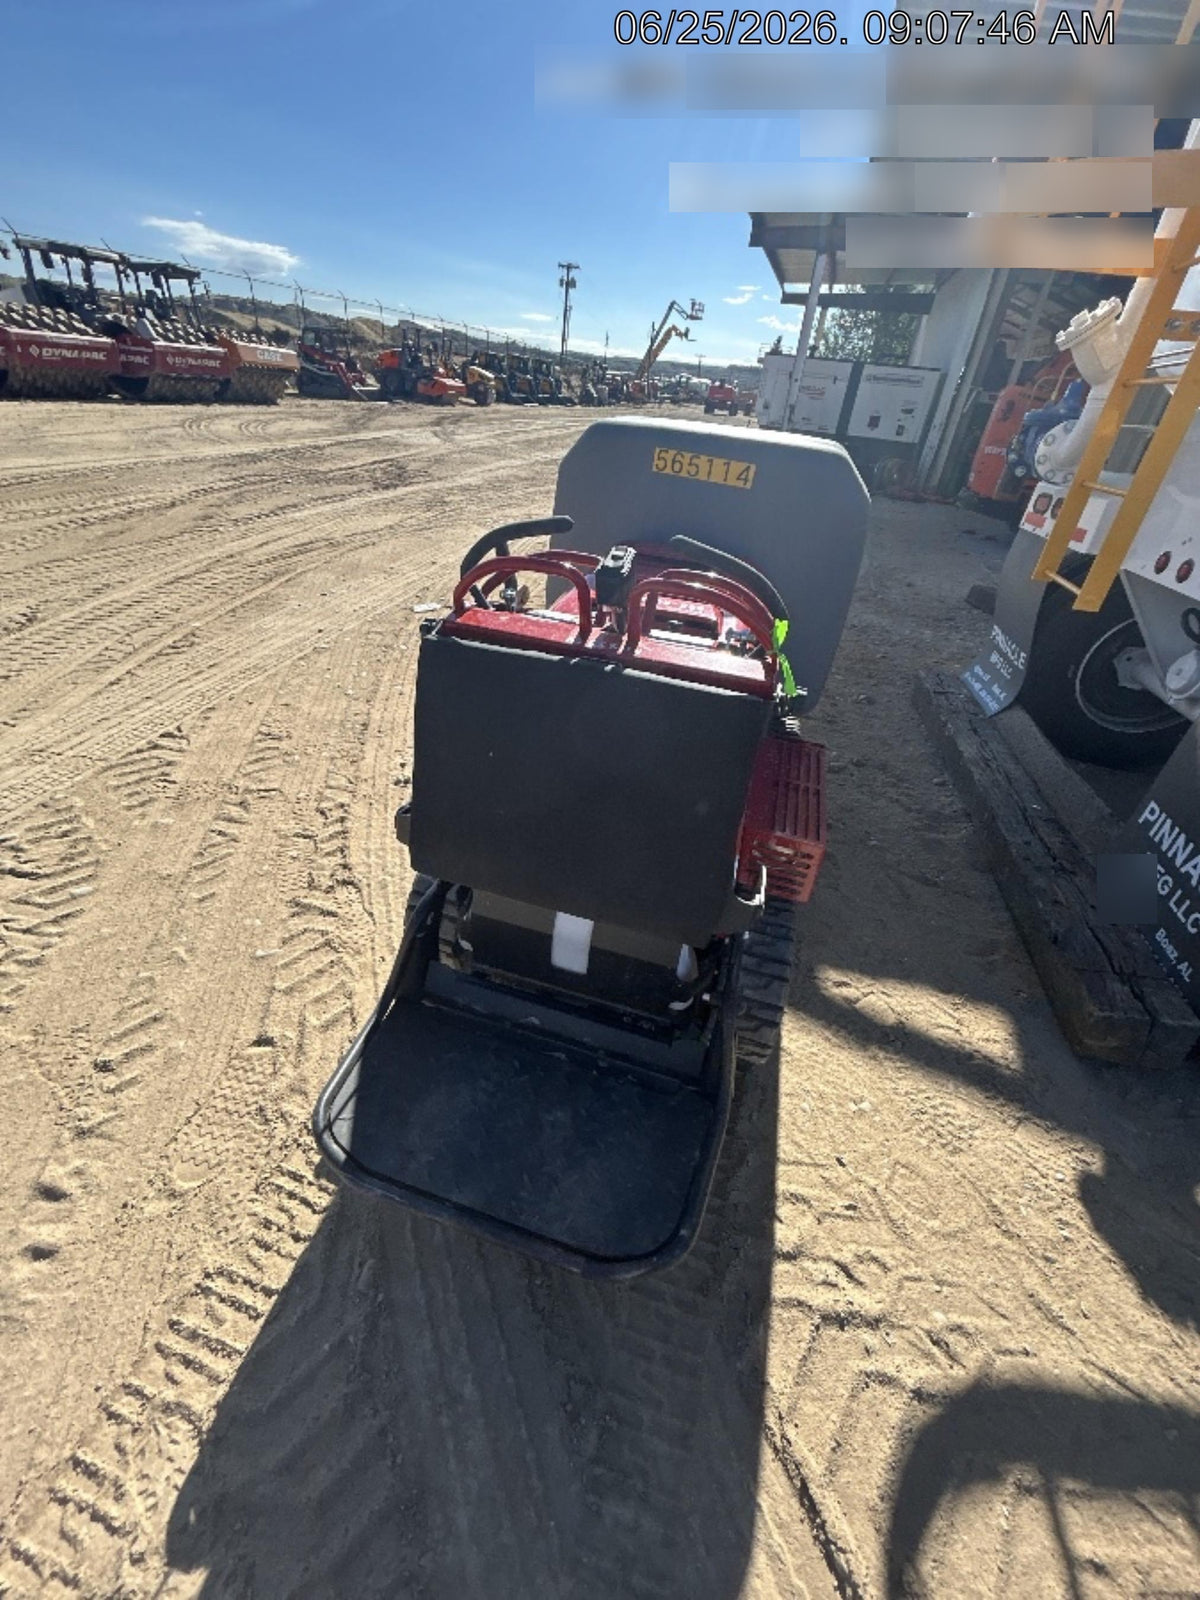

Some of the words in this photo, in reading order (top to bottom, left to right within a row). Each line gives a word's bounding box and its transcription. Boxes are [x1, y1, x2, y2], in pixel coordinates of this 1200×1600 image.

[120, 353, 150, 366] APAC
[654, 449, 752, 486] 565114
[1138, 800, 1200, 889] PINNA
[1168, 888, 1200, 934] LLC
[1176, 960, 1193, 982] AL
